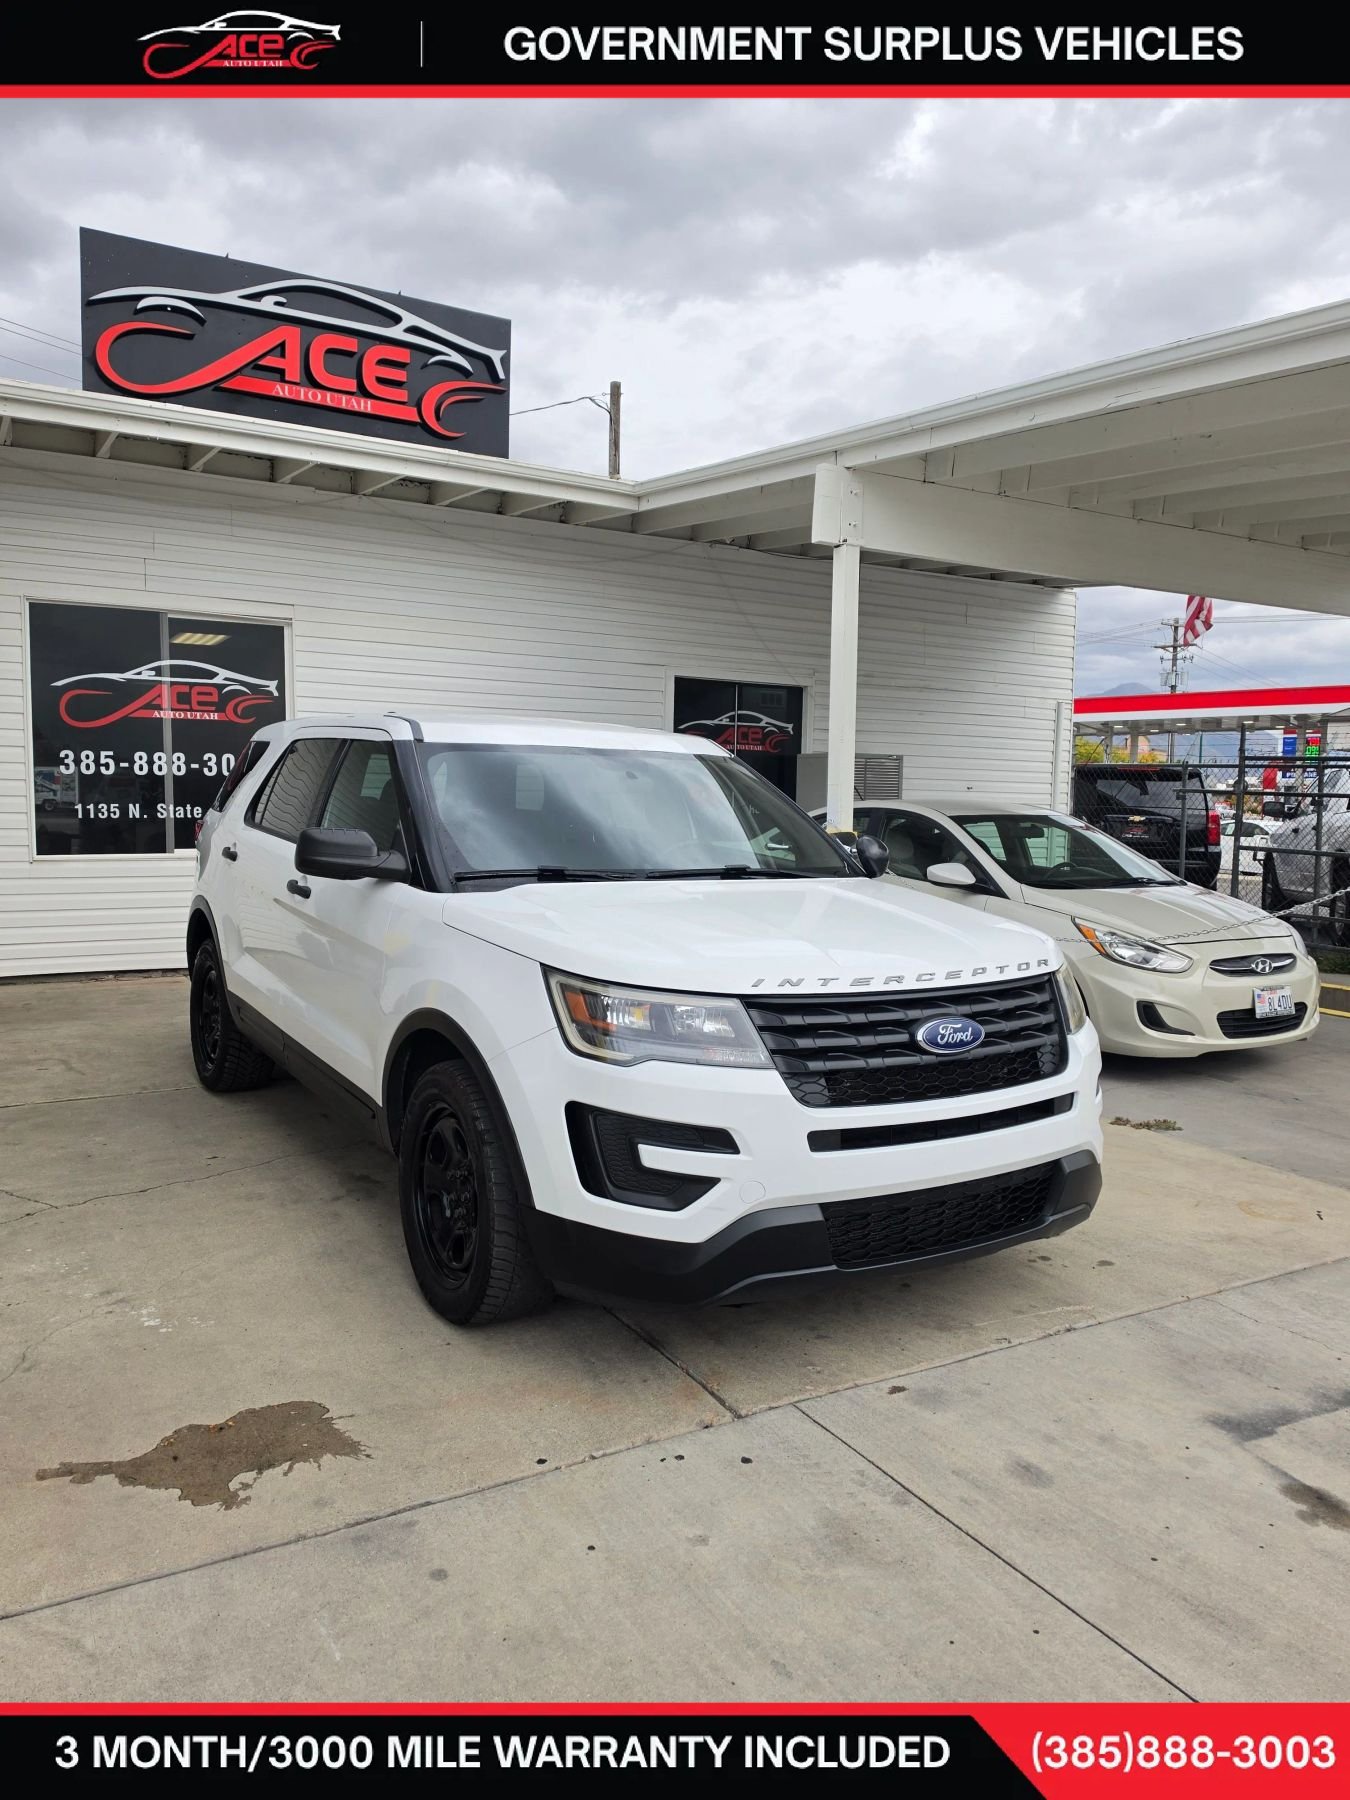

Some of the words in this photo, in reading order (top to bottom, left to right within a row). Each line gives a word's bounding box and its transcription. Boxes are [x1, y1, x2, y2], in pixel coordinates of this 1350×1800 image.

[240, 325, 412, 403] ACE
[272, 384, 322, 402] AUTO
[325, 391, 372, 412] UTAH
[152, 710, 184, 719] AUTO
[186, 711, 219, 720] UTAH
[59, 750, 236, 776] 385-888-30
[74, 803, 120, 819] 1135
[128, 803, 148, 819] N.
[156, 803, 202, 819] State
[751, 957, 1050, 988] INTERCEPTOR
[937, 1023, 974, 1044] Ford
